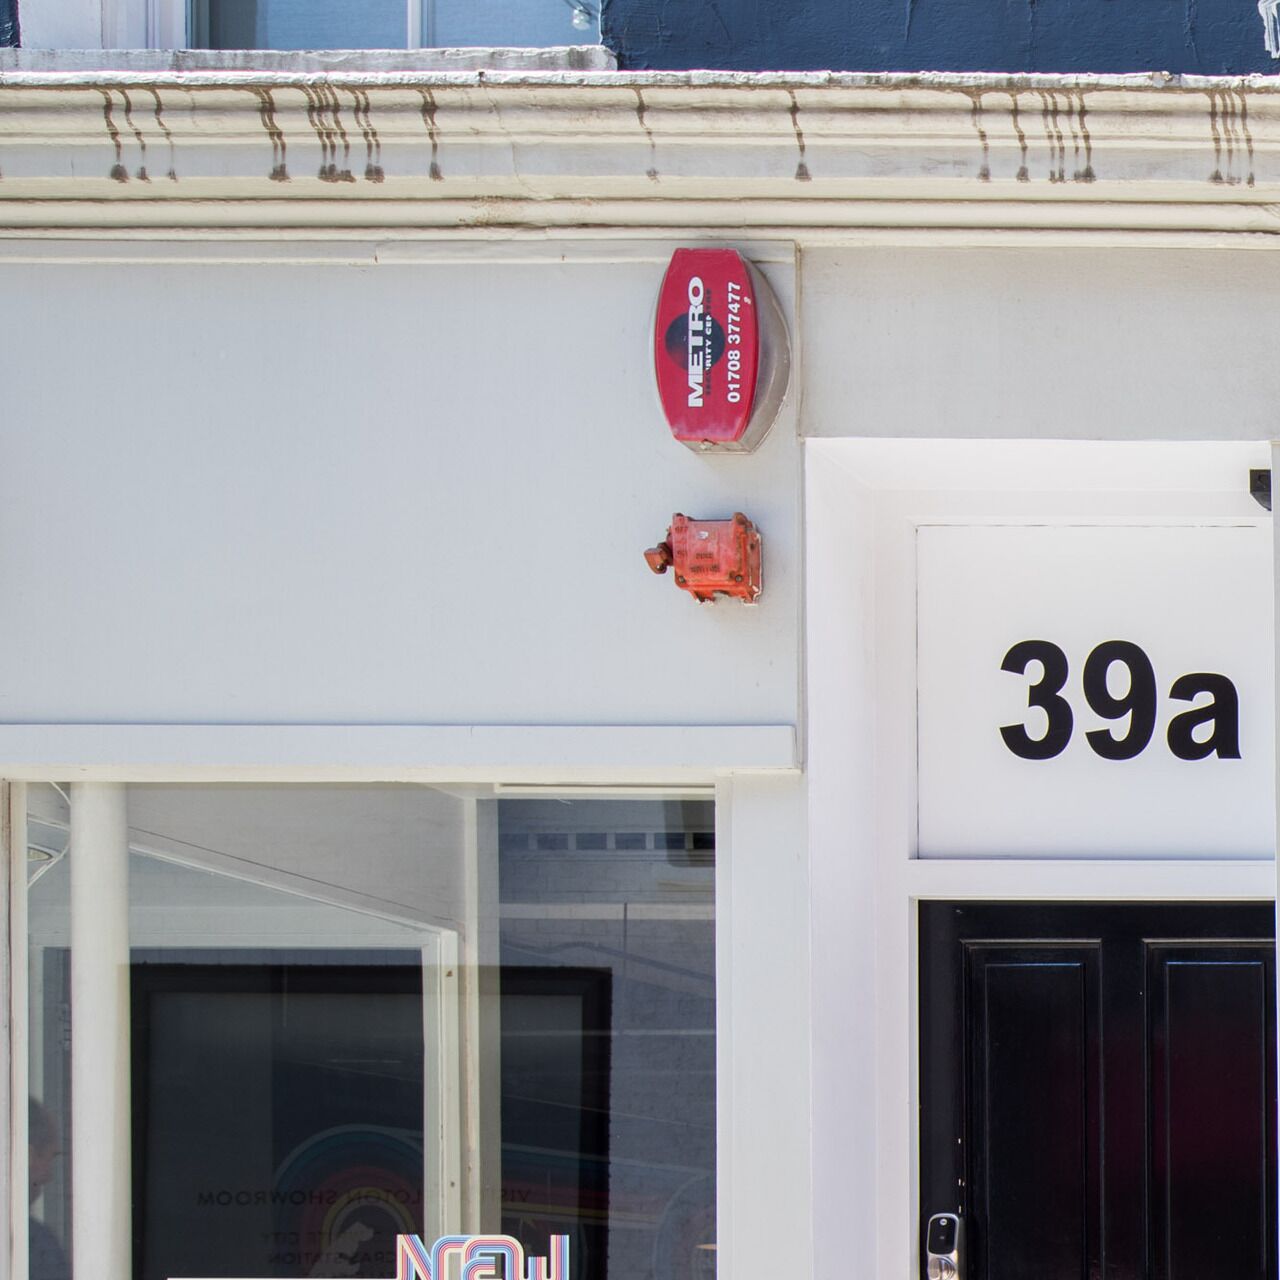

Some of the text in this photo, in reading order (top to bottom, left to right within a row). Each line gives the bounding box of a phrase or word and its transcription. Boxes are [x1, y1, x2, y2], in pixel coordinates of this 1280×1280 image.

[688, 276, 704, 408] METRO
[727, 281, 741, 345] 377477
[727, 349, 741, 403] 01708
[1000, 640, 1241, 761] 39a
